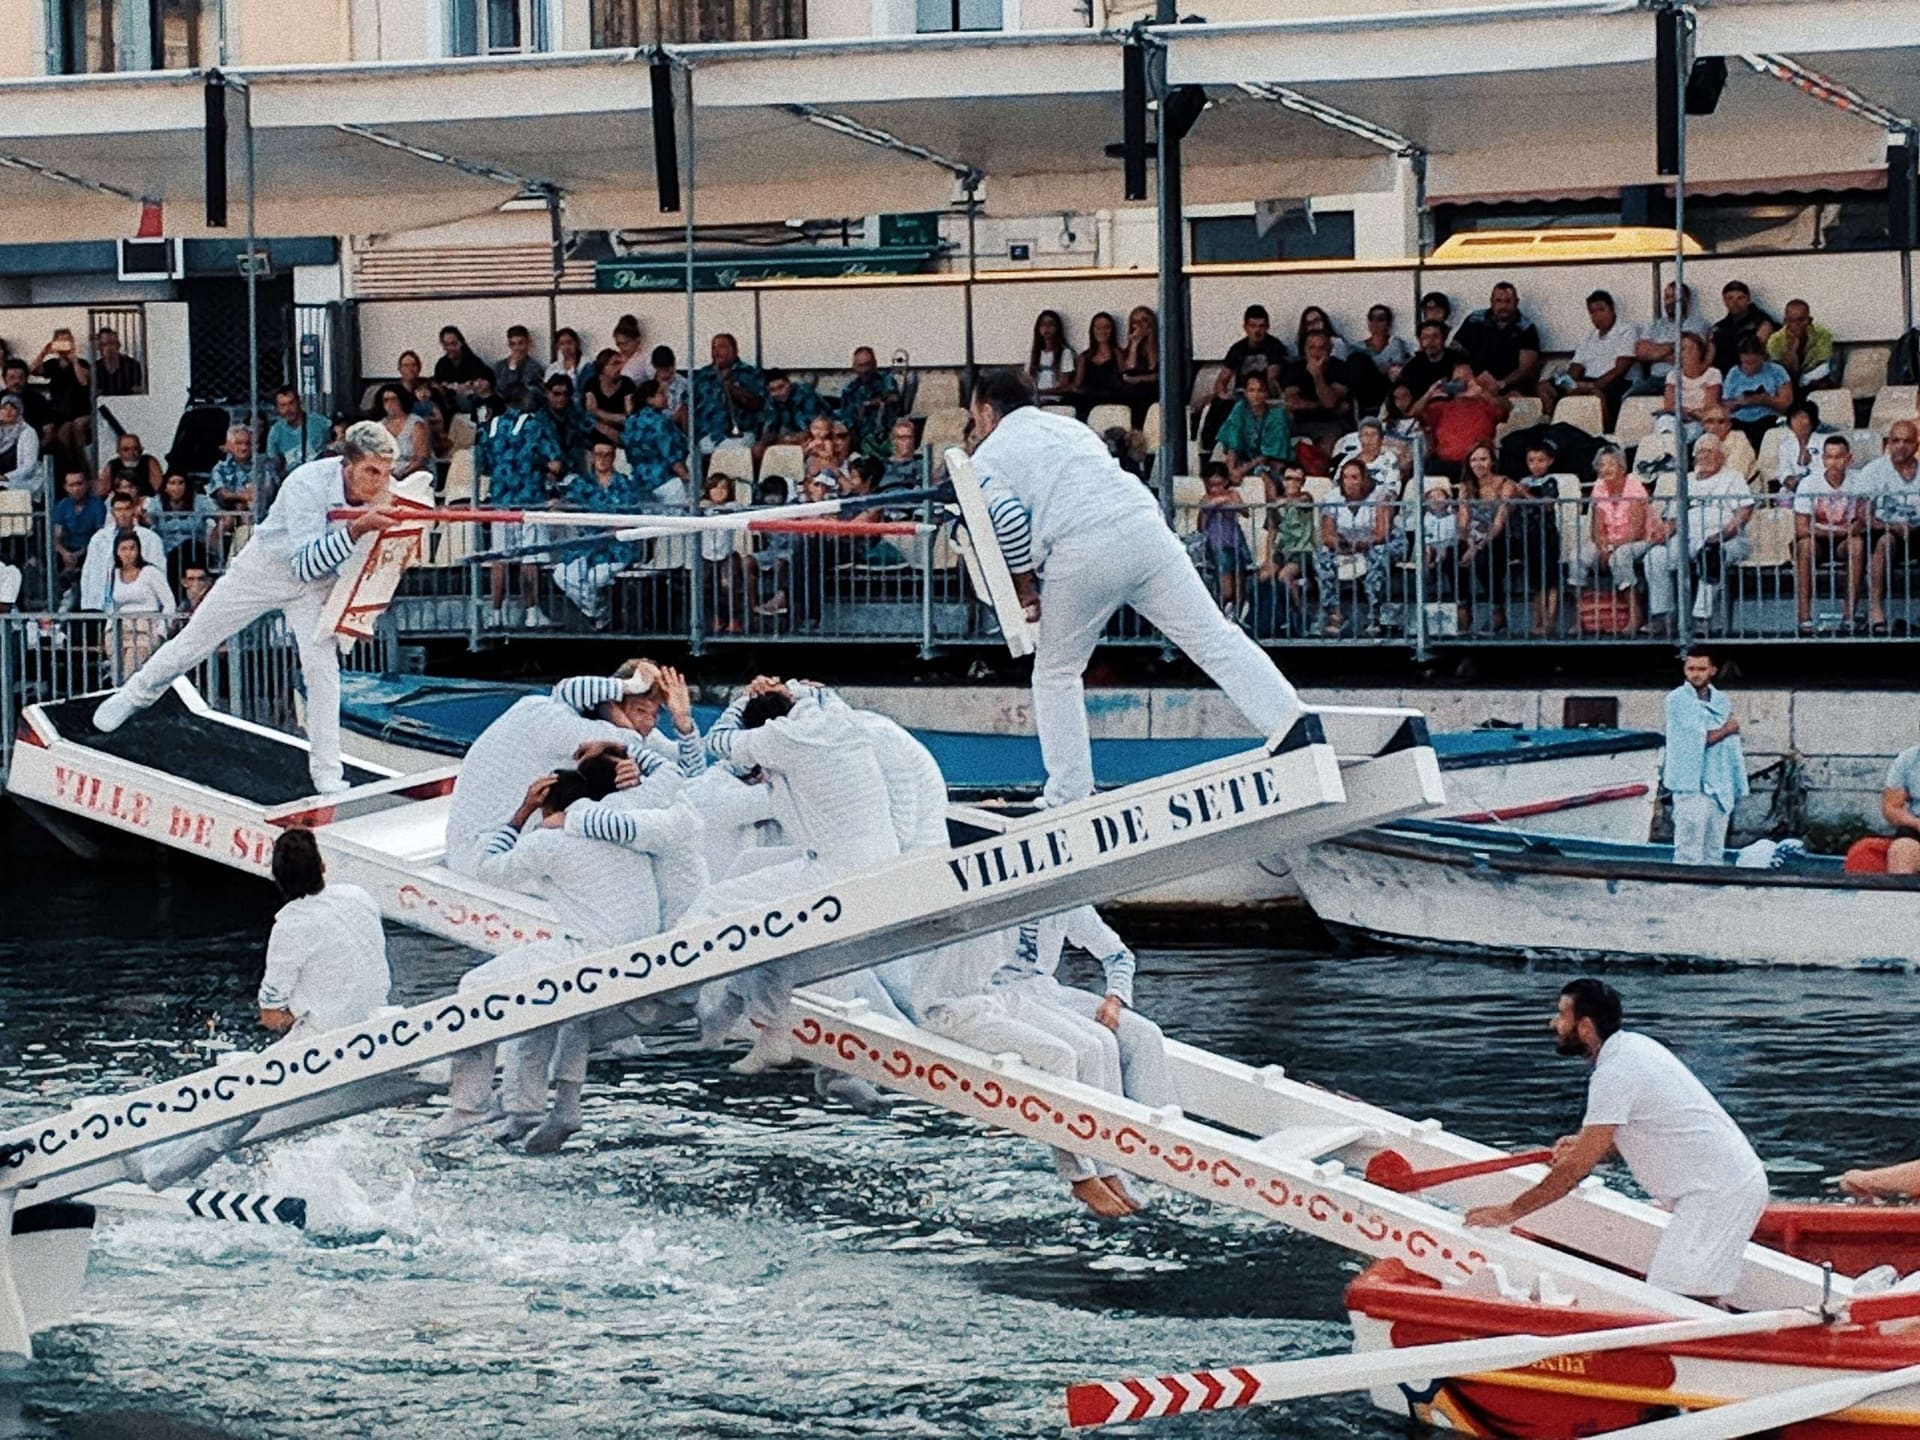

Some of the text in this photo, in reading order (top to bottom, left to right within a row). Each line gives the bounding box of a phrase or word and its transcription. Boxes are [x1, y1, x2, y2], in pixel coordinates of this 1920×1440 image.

[55, 766, 274, 868] VILLE DE SE
[948, 767, 1282, 893] VILLE DE SETE
